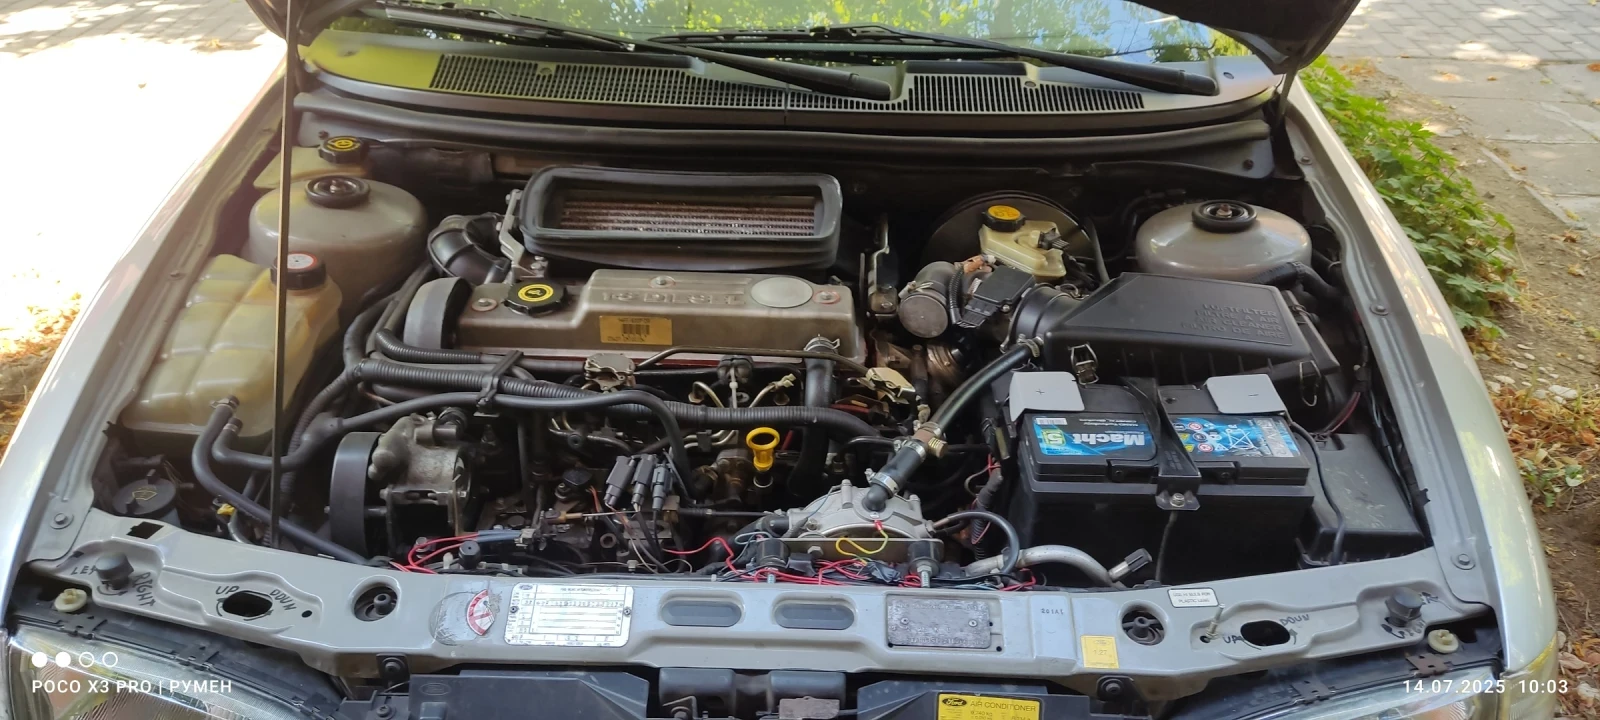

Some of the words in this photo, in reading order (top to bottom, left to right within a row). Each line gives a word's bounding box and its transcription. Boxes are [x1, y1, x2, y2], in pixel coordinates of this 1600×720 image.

[1259, 315, 1280, 324] AIR
[1223, 319, 1283, 332] CLEANER
[1232, 326, 1251, 336] DE
[1256, 329, 1285, 339] AIRE
[1071, 432, 1145, 446] Macht
[215, 585, 240, 595] UP
[984, 702, 1036, 712] CONDITIONER
